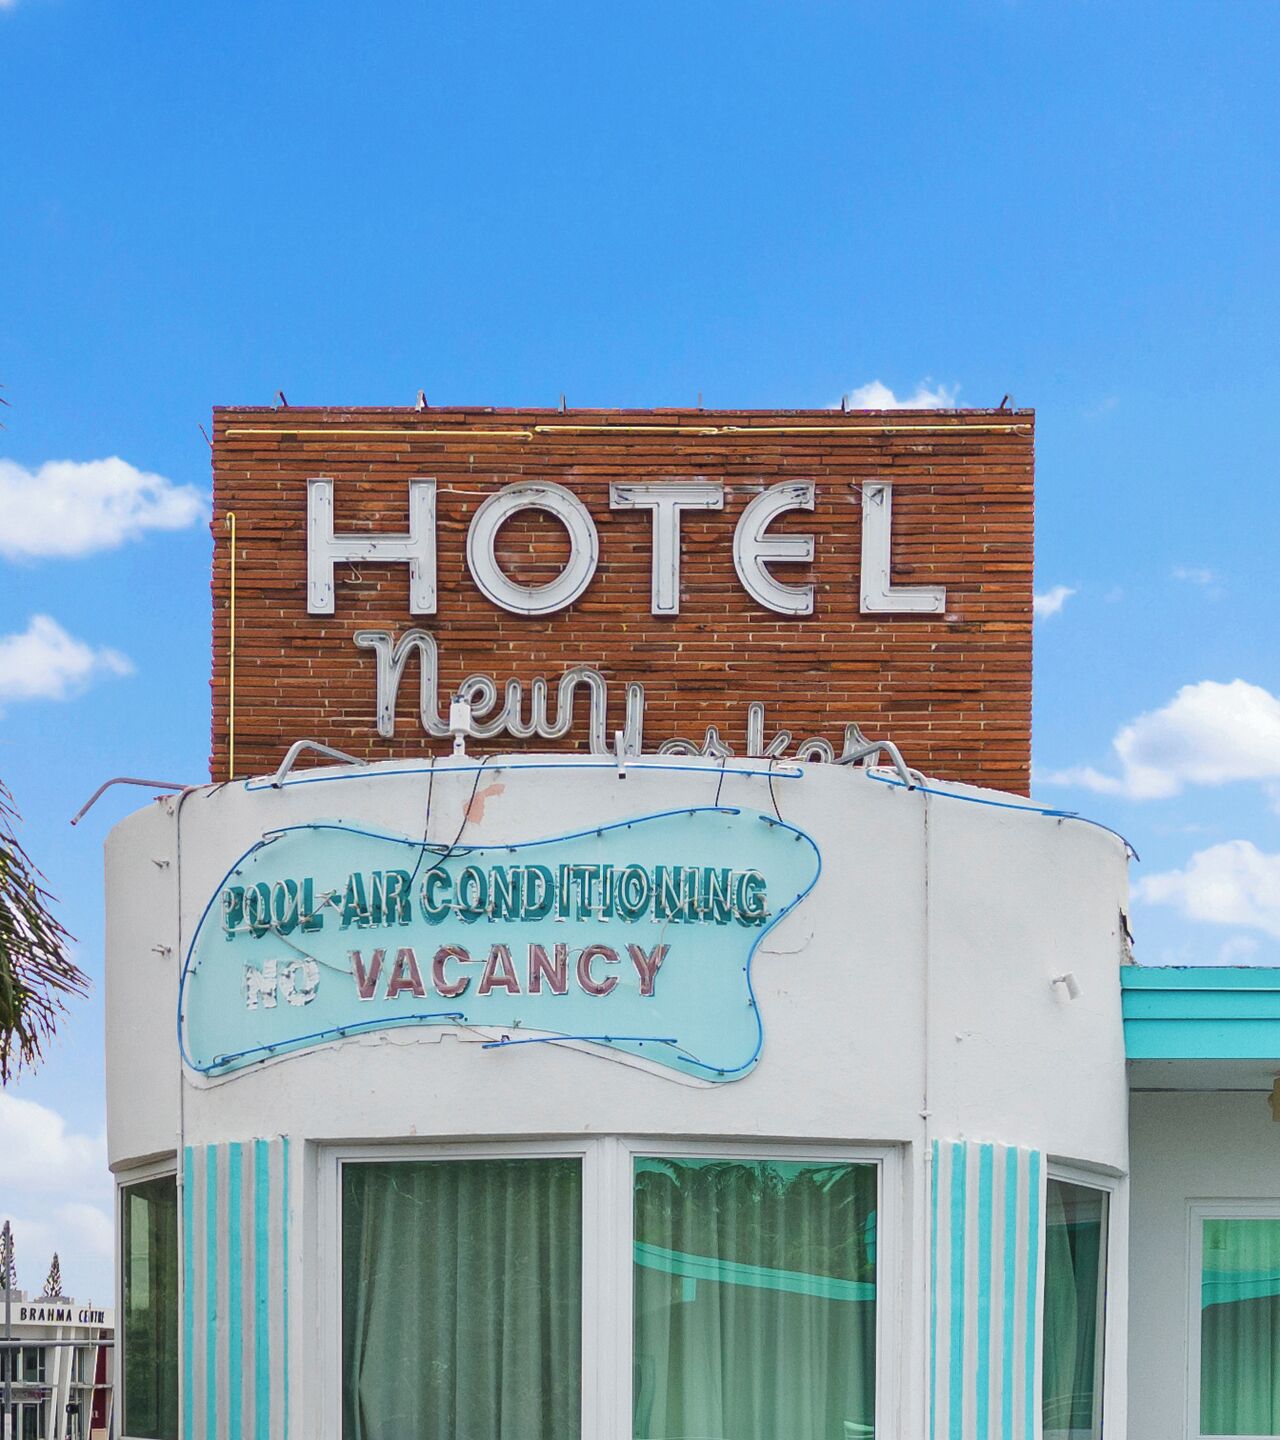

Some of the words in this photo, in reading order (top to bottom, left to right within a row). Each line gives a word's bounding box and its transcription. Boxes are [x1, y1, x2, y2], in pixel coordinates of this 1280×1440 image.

[305, 476, 947, 615] HOTEL
[353, 628, 566, 738] New
[420, 863, 771, 927] CONDITIONING
[241, 957, 319, 1011] NO
[347, 942, 671, 1000] VACANCY
[20, 1307, 72, 1322] BRAHMA
